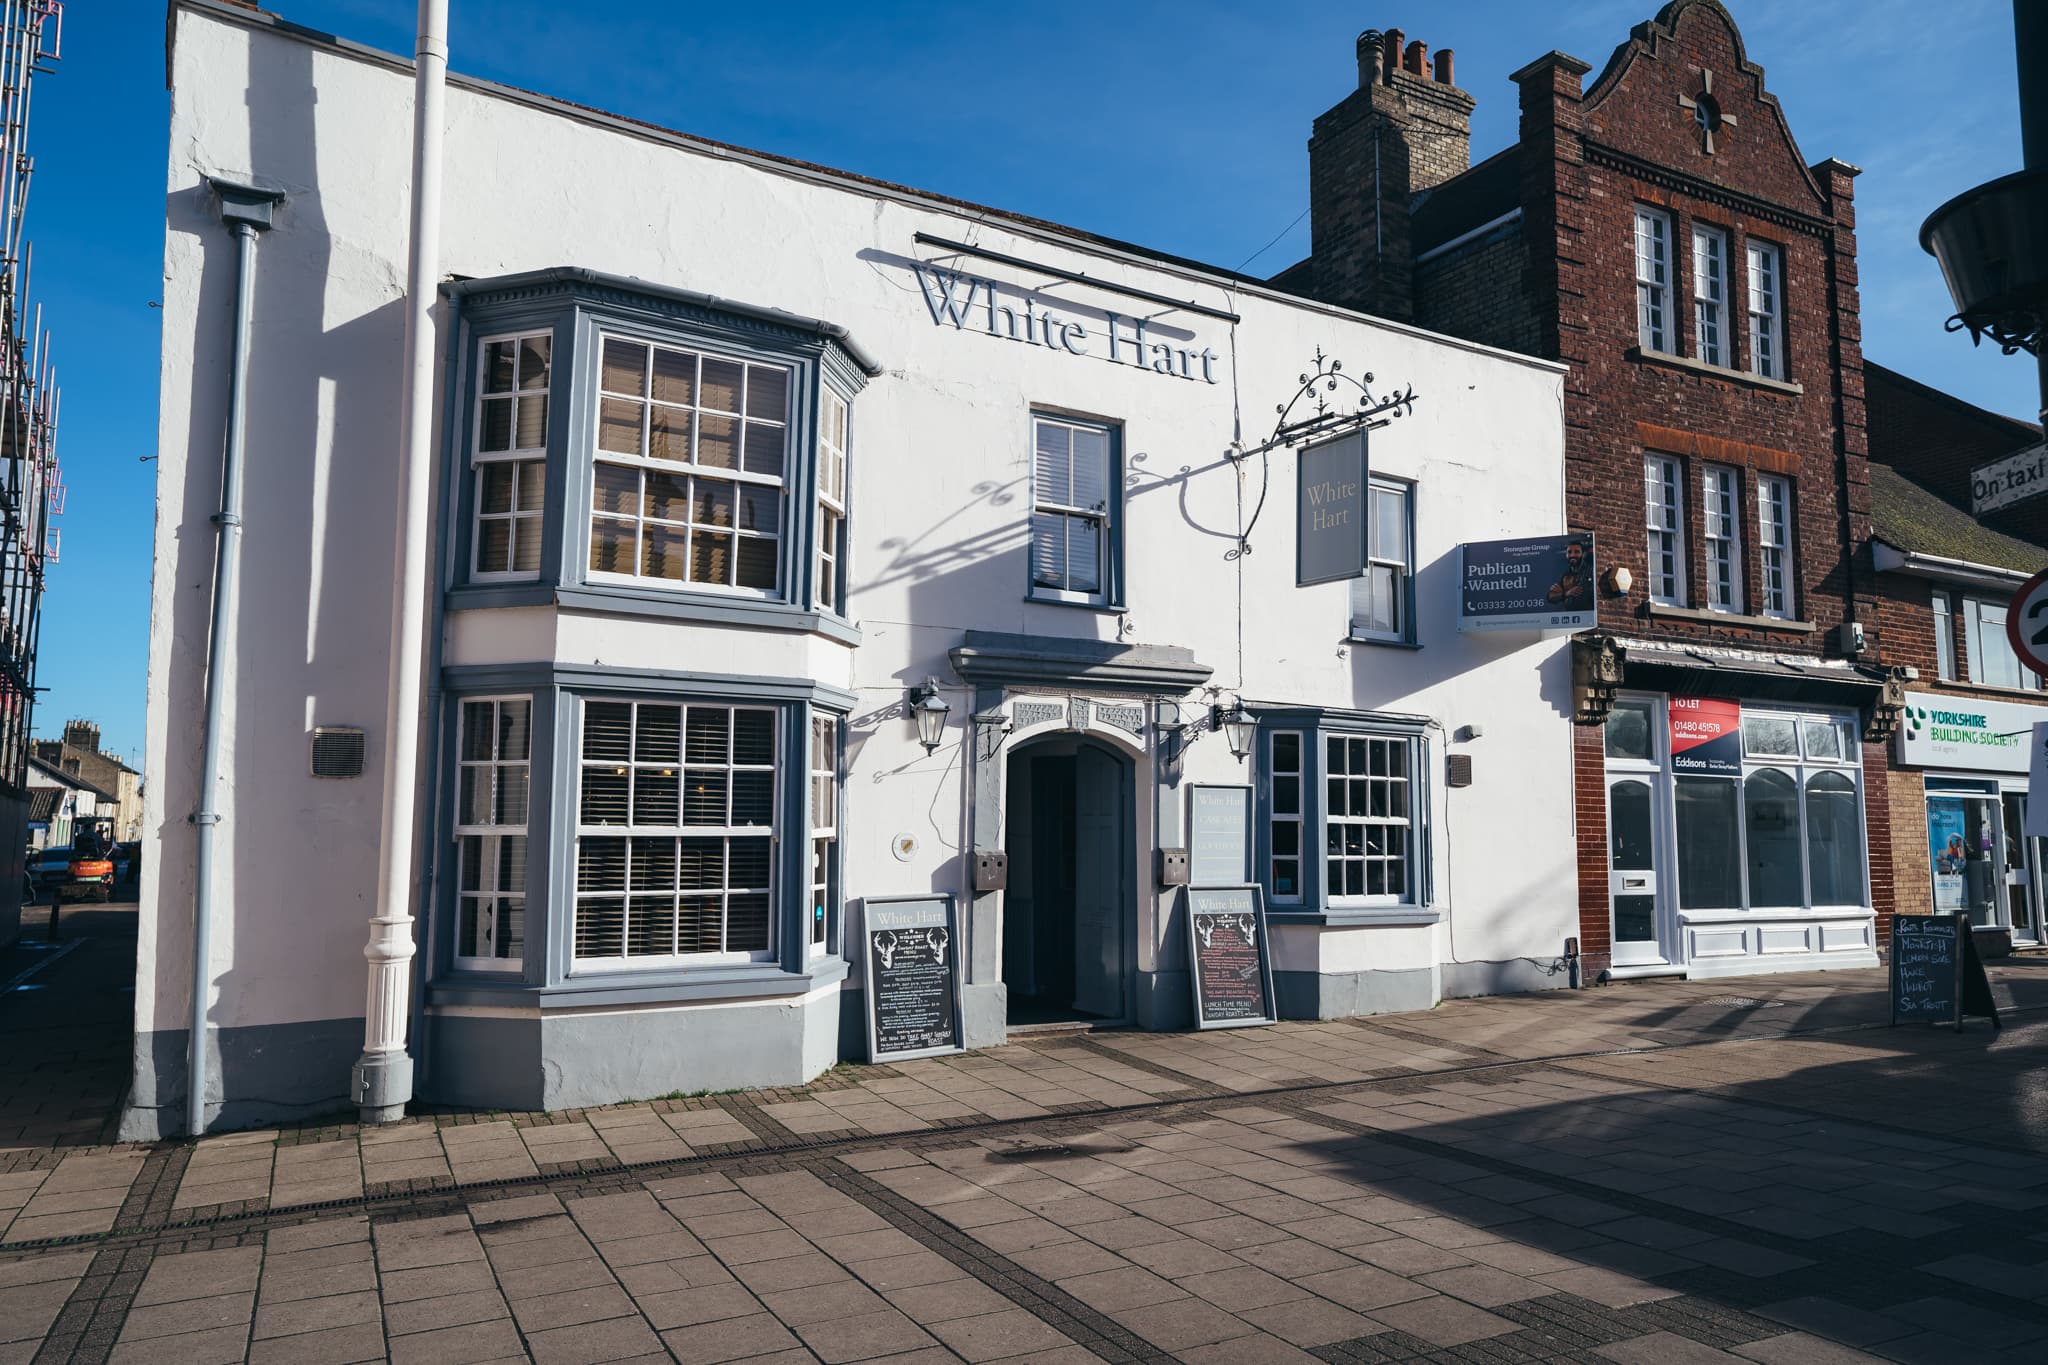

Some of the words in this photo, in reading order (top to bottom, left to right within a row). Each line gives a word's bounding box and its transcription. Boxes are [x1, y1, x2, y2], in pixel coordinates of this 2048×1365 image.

[911, 263, 1089, 356] White
[1105, 311, 1220, 385] Hart
[1307, 480, 1357, 506] White
[1974, 479, 1999, 501] On
[1312, 508, 1350, 531] Hart
[1468, 562, 1531, 577] Publican
[1467, 576, 1528, 592] Wanted!
[1477, 600, 1506, 610] 03333
[1508, 599, 1525, 609] 200
[1526, 598, 1545, 608] 036
[1675, 698, 1686, 708] TO
[1687, 699, 1700, 709] LET
[1674, 721, 1697, 731] 01480
[1698, 722, 1721, 733] 451578
[1930, 709, 1987, 729] YORKSHIRE
[1930, 727, 1978, 744] BUILDING
[1979, 731, 2019, 748] SOCIETY
[1675, 756, 1707, 769] Eddisons
[1198, 898, 1228, 909] White
[1229, 896, 1250, 909] Hart
[878, 911, 913, 926] White
[915, 909, 944, 923] Hart
